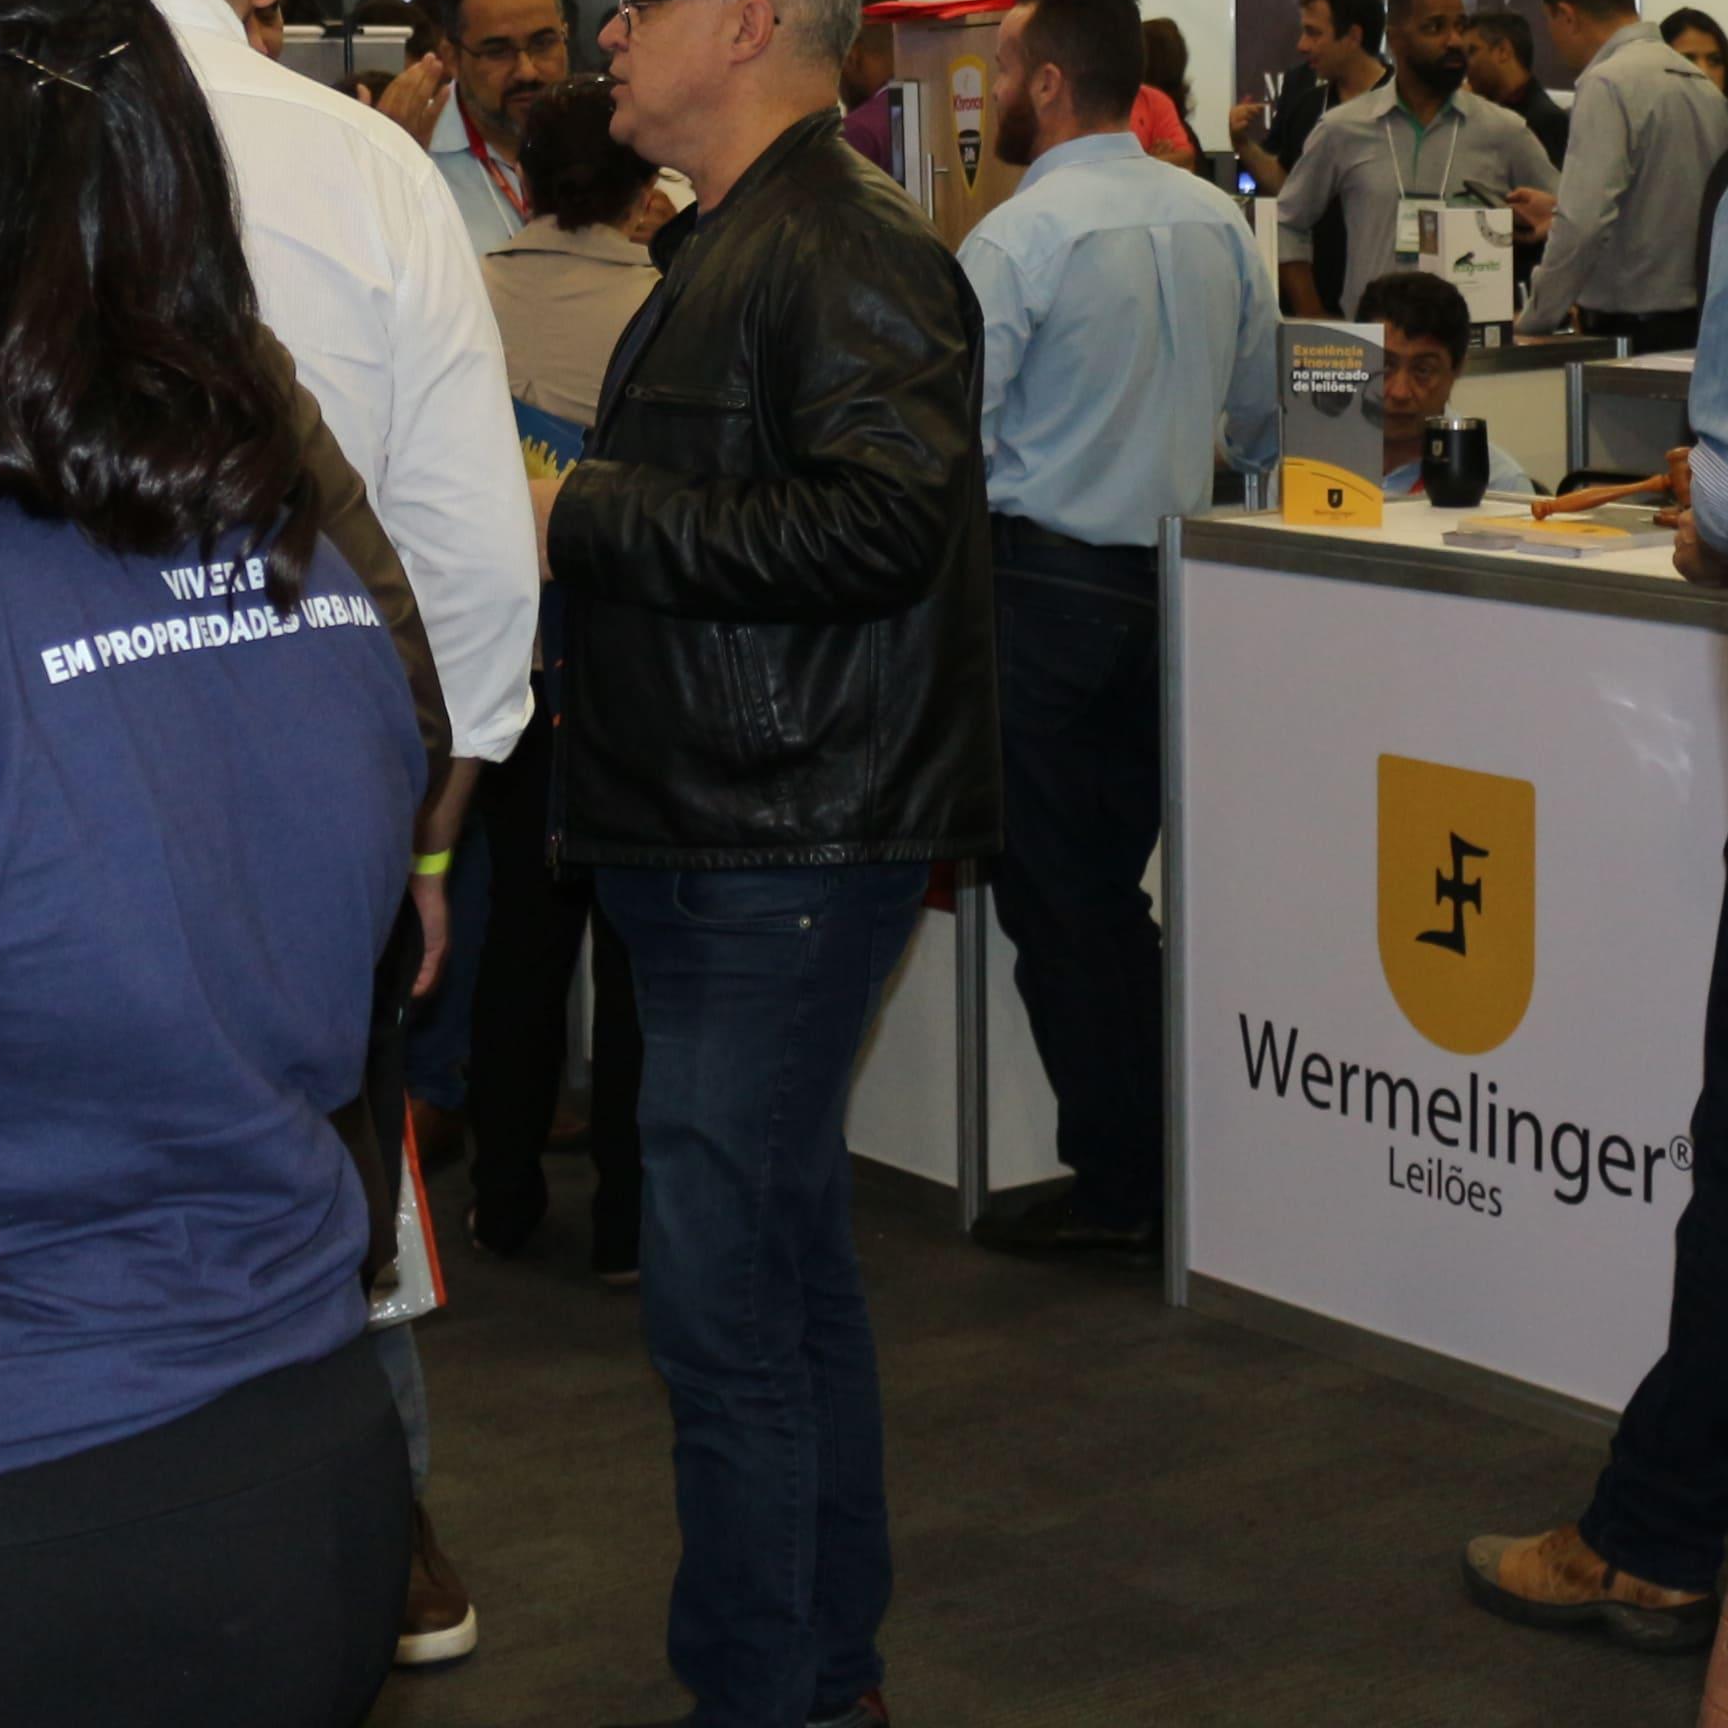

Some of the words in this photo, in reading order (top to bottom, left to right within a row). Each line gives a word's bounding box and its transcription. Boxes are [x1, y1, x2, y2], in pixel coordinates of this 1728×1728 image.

[1292, 344, 1364, 357] Excelência
[1303, 357, 1363, 370] inovação
[1292, 370, 1309, 381] no
[1312, 368, 1369, 381] mercado
[1292, 381, 1309, 392] de
[1312, 380, 1357, 393] leilões.
[41, 639, 97, 685] EM
[301, 594, 381, 630] URBNA
[1389, 1145, 1503, 1218] Leilões
